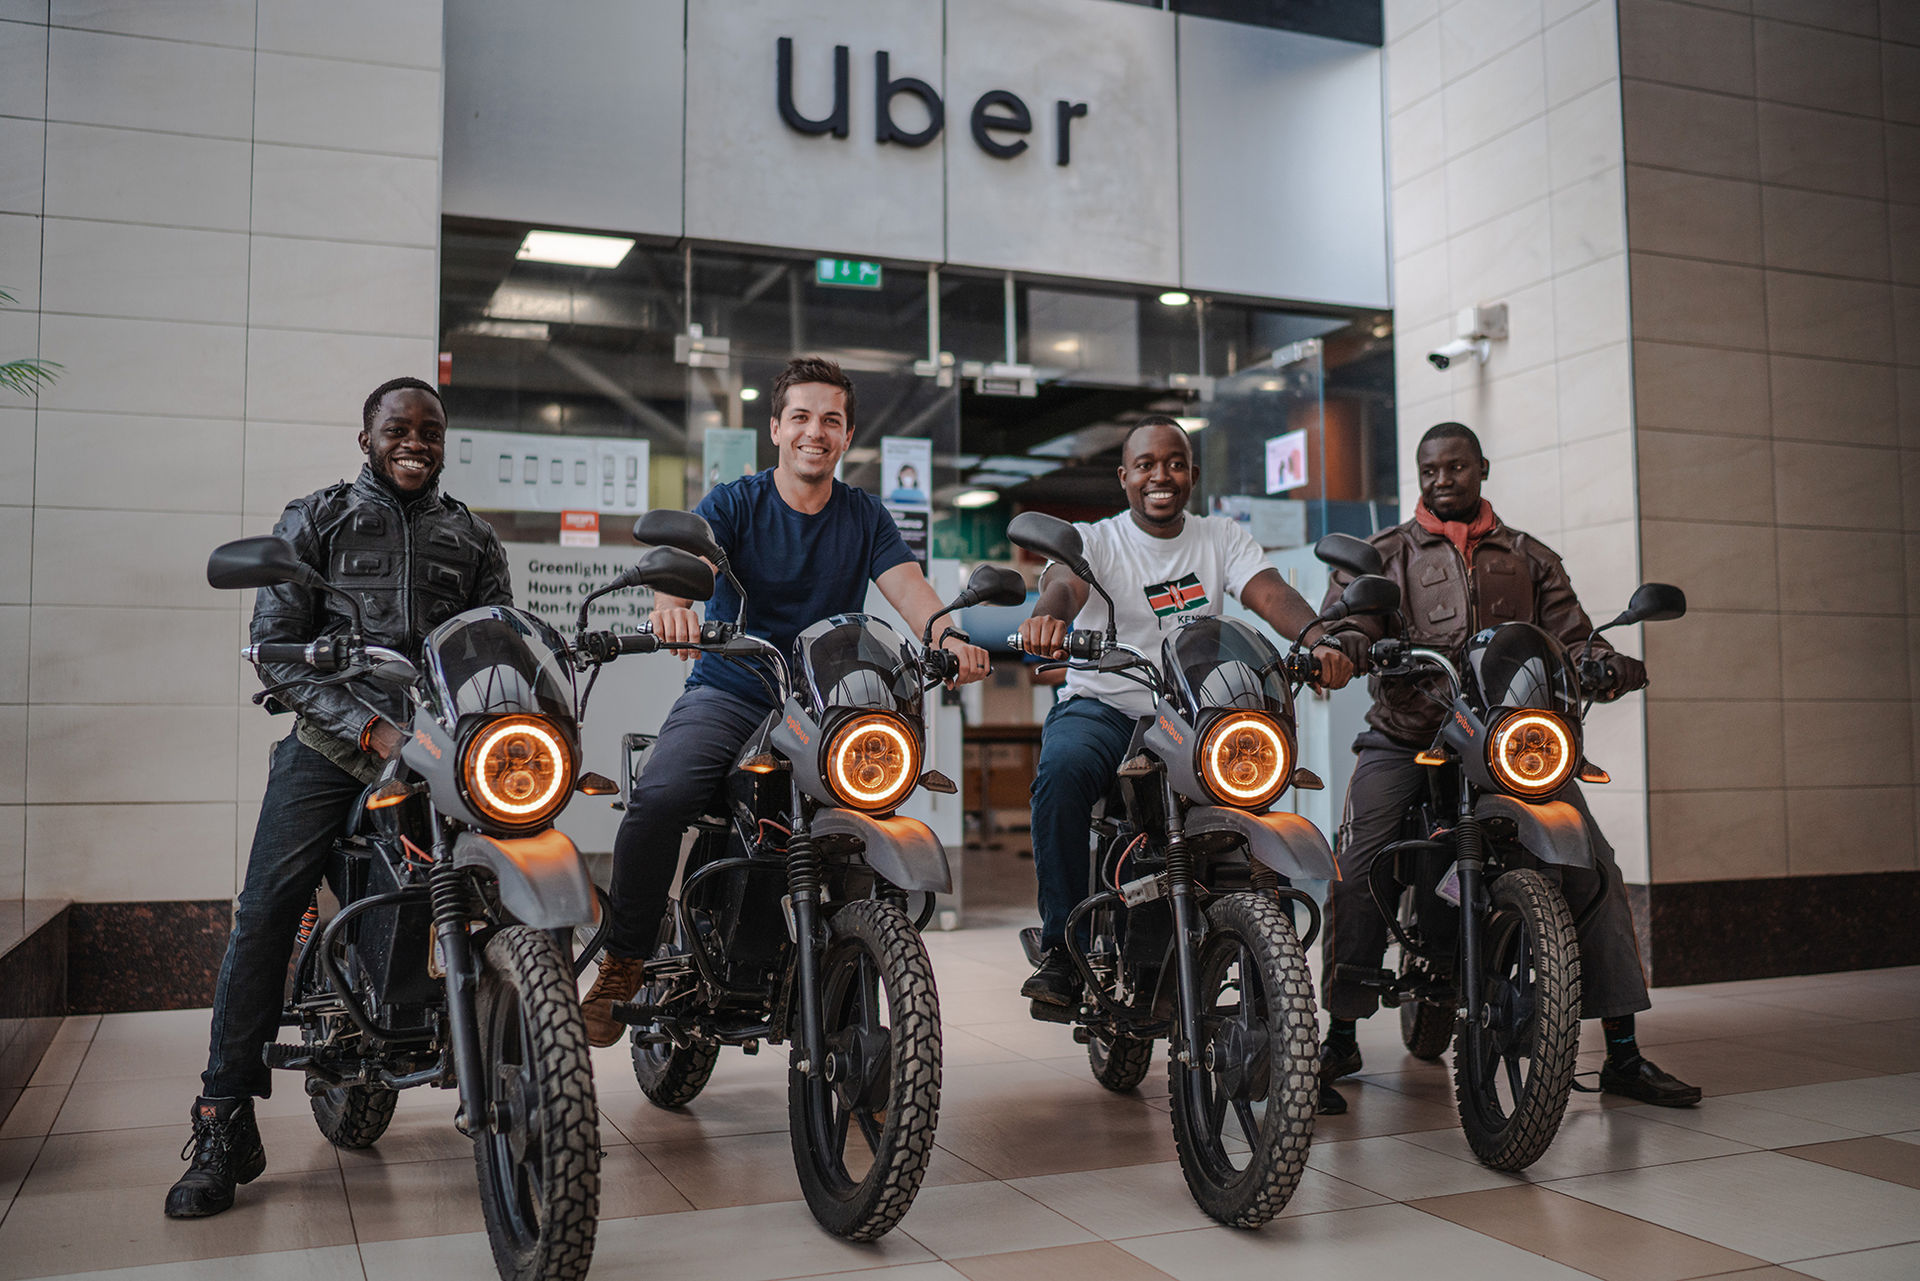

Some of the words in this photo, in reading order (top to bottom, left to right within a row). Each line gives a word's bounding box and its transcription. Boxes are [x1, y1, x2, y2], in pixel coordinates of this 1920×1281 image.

[777, 36, 1088, 166] Uber
[528, 560, 607, 577] Greenlight
[528, 580, 572, 594] Hours
[578, 582, 595, 595] Of
[786, 715, 809, 745] opibus
[1160, 715, 1184, 745] opibus
[1455, 711, 1475, 737] opibus
